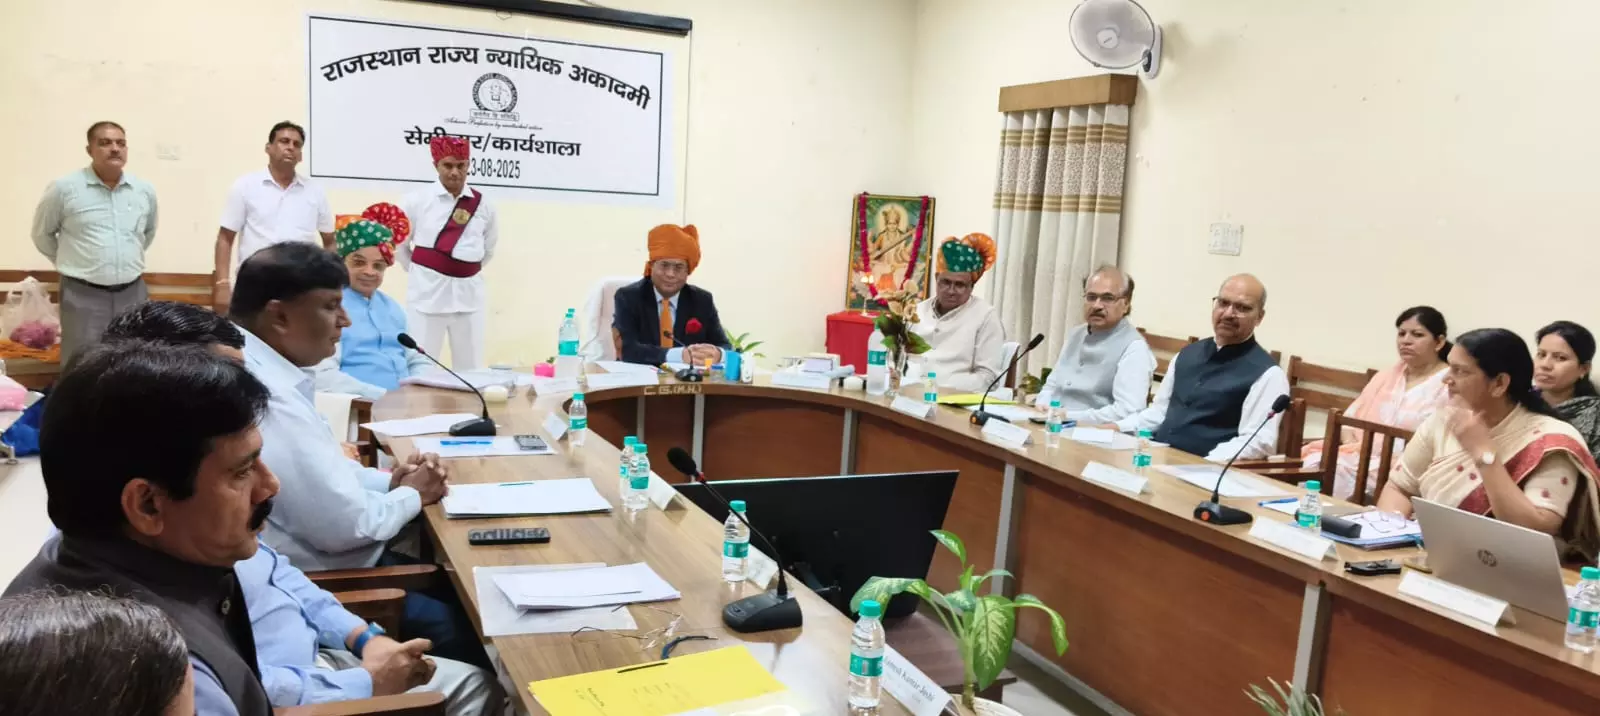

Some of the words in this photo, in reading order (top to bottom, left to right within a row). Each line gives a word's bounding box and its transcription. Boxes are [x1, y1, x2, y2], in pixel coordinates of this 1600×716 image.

[320, 47, 421, 82] राजस्थान
[427, 46, 479, 64] राज्य
[485, 46, 564, 75] न्यायिक
[568, 64, 651, 110] अकादमी
